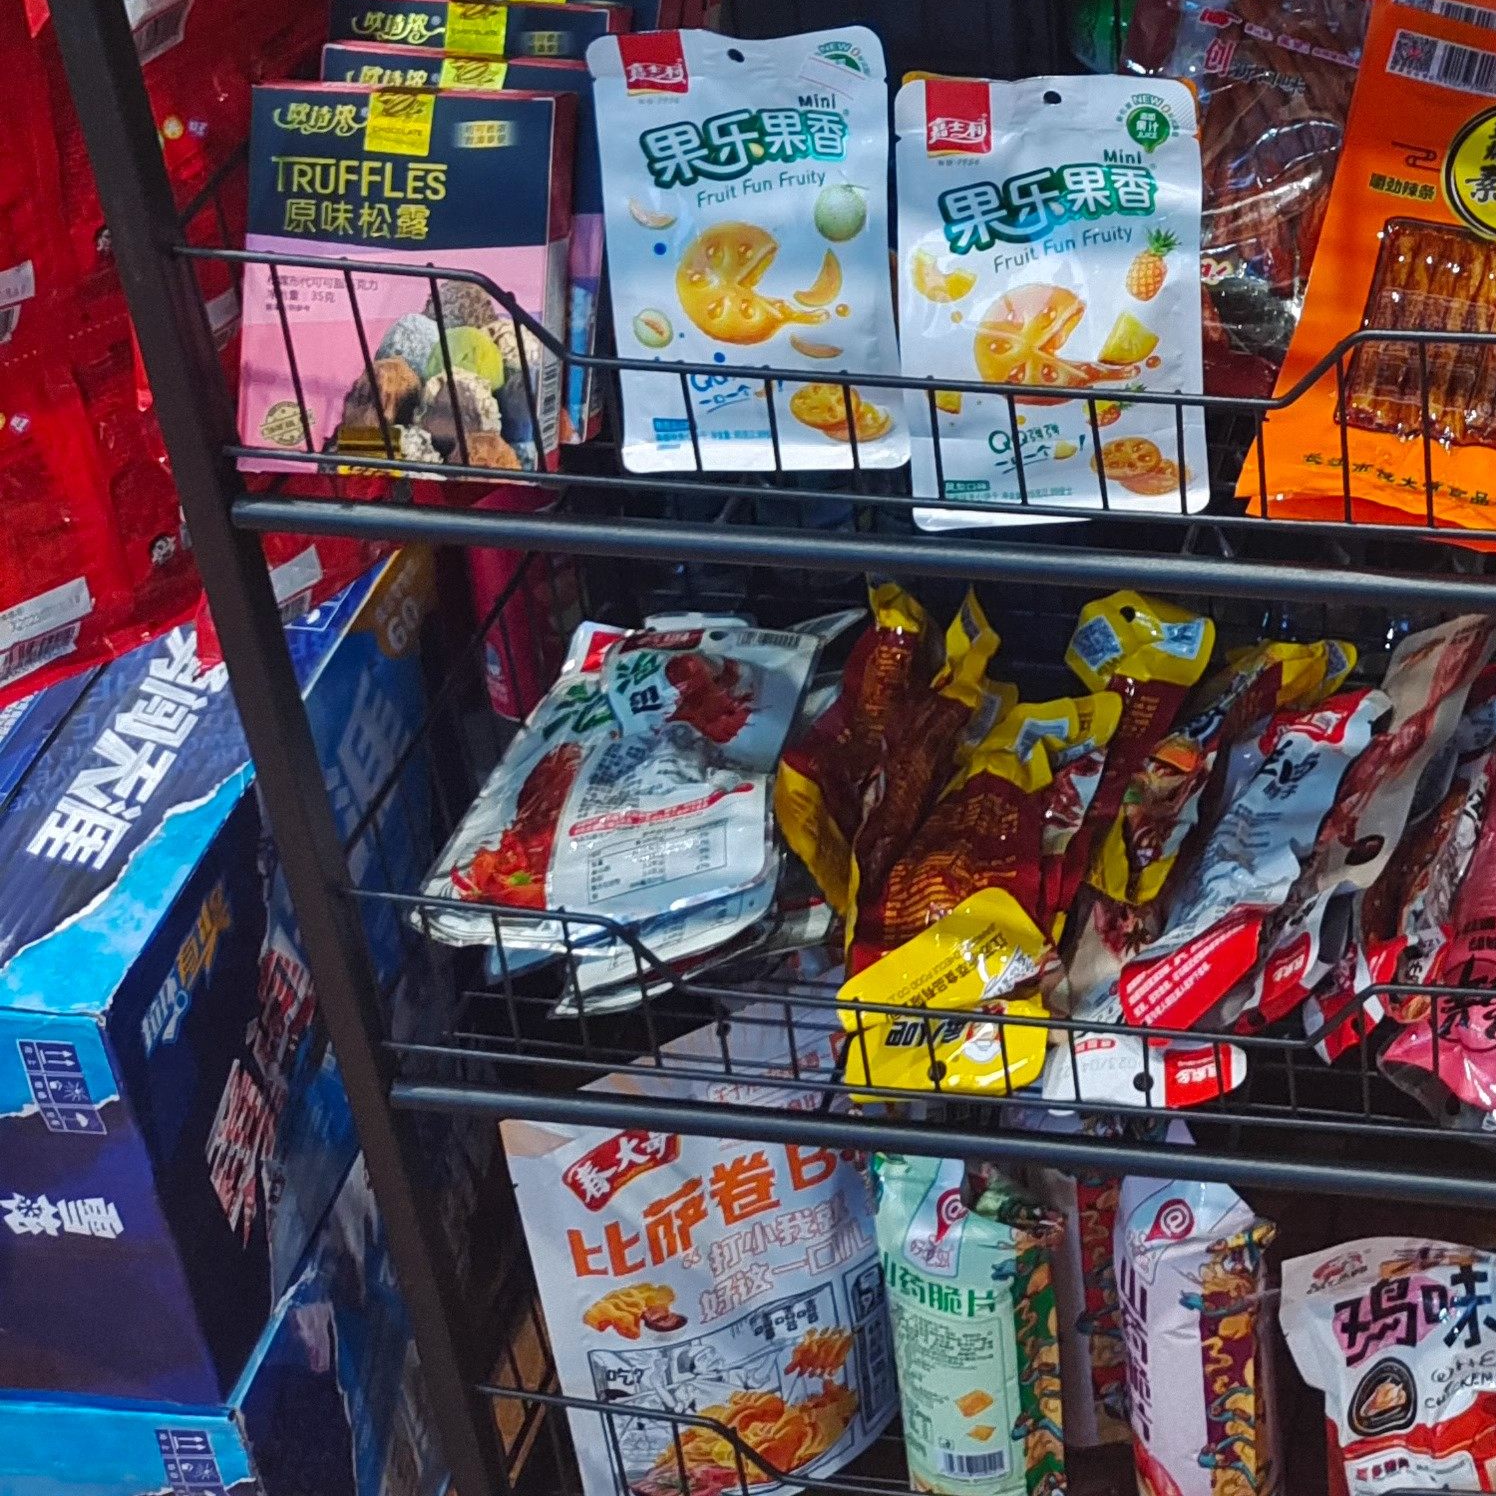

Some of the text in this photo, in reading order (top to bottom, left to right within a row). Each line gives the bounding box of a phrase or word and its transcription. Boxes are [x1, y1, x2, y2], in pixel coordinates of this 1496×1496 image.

[797, 93, 837, 109] Mini
[645, 108, 846, 184] 果乐果香
[1103, 149, 1142, 165] Mini
[271, 155, 449, 201] TRUFFLES
[696, 168, 827, 208] Fruit Fun Fruity
[283, 197, 431, 241] 原味松露
[942, 165, 1152, 249] 果乐果香
[993, 225, 1134, 274] Fruit Fun Fruity
